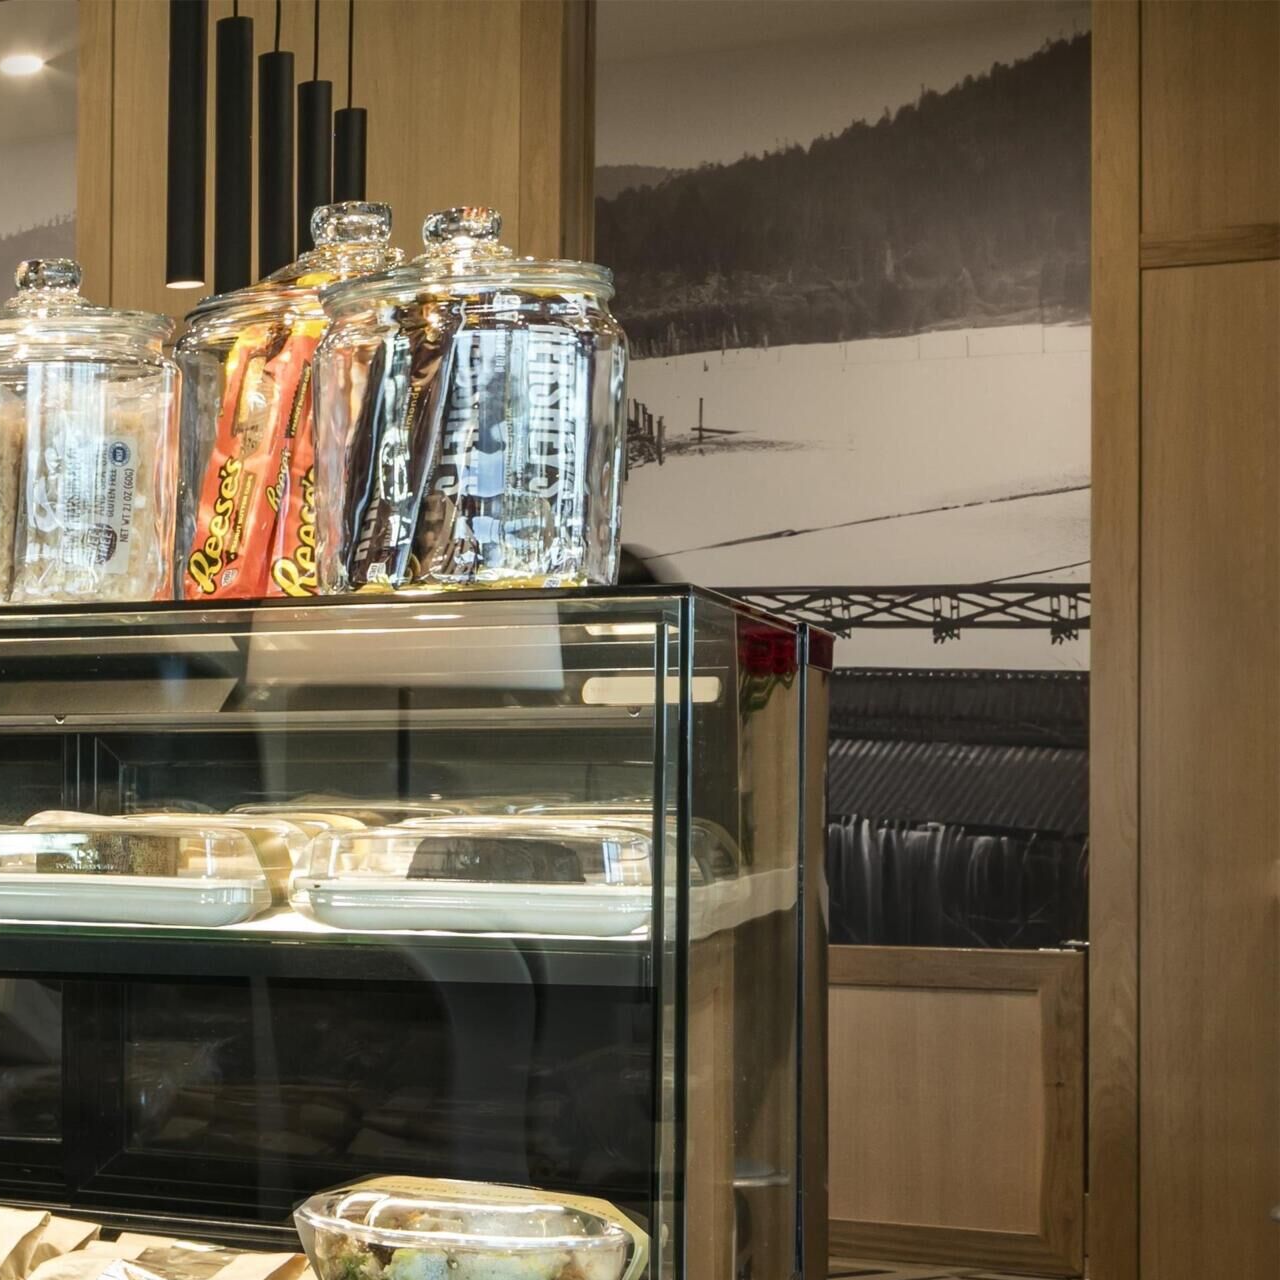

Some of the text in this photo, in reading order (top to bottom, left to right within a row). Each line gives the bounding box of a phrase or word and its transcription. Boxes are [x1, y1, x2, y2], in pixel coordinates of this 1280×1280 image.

[122, 514, 129, 525] WT
[189, 456, 242, 593] Reese's
[120, 528, 128, 542] NET
